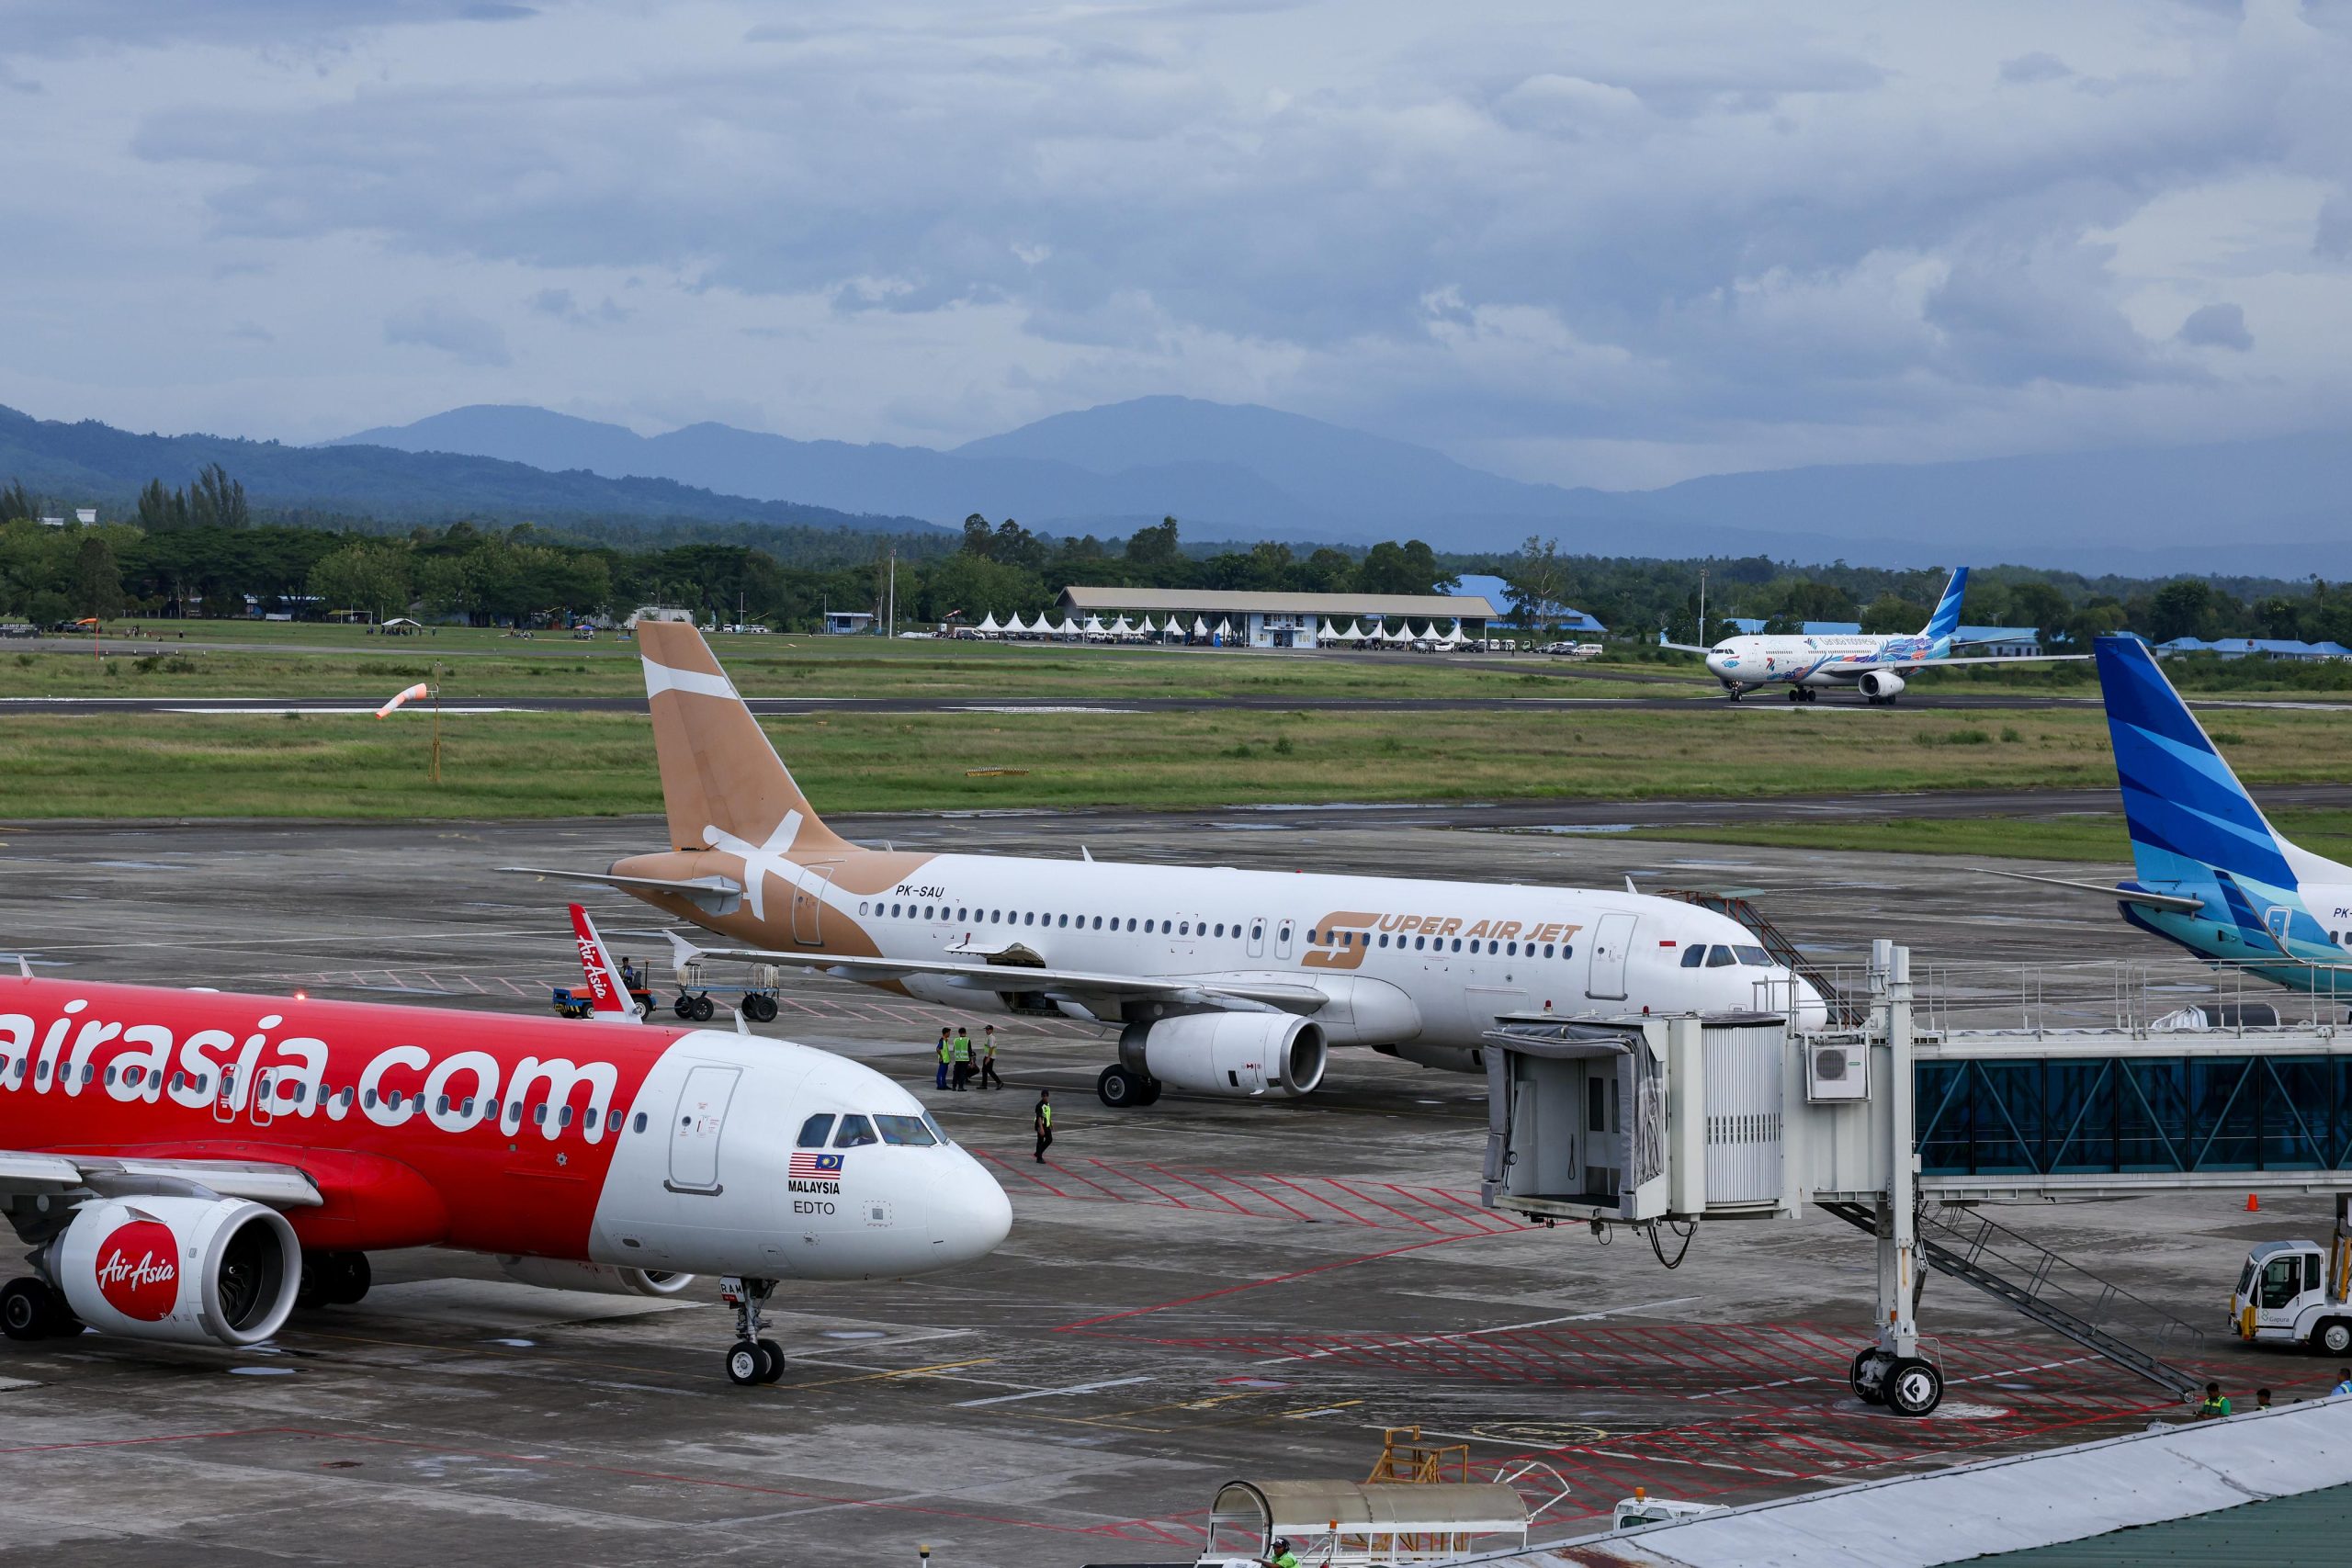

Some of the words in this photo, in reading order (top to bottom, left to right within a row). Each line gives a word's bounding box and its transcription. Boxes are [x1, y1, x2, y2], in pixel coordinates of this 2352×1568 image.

[896, 885, 944, 897] PK-SAU
[1464, 919, 1522, 940] AIR
[1523, 923, 1583, 942] JET
[577, 935, 595, 962] Air
[583, 962, 607, 998] Asia
[788, 1179, 840, 1195] MALAYSIA
[794, 1201, 835, 1214] EDTO
[98, 1248, 132, 1290] Air
[130, 1250, 175, 1292] Asia
[720, 1283, 743, 1293] RAM
